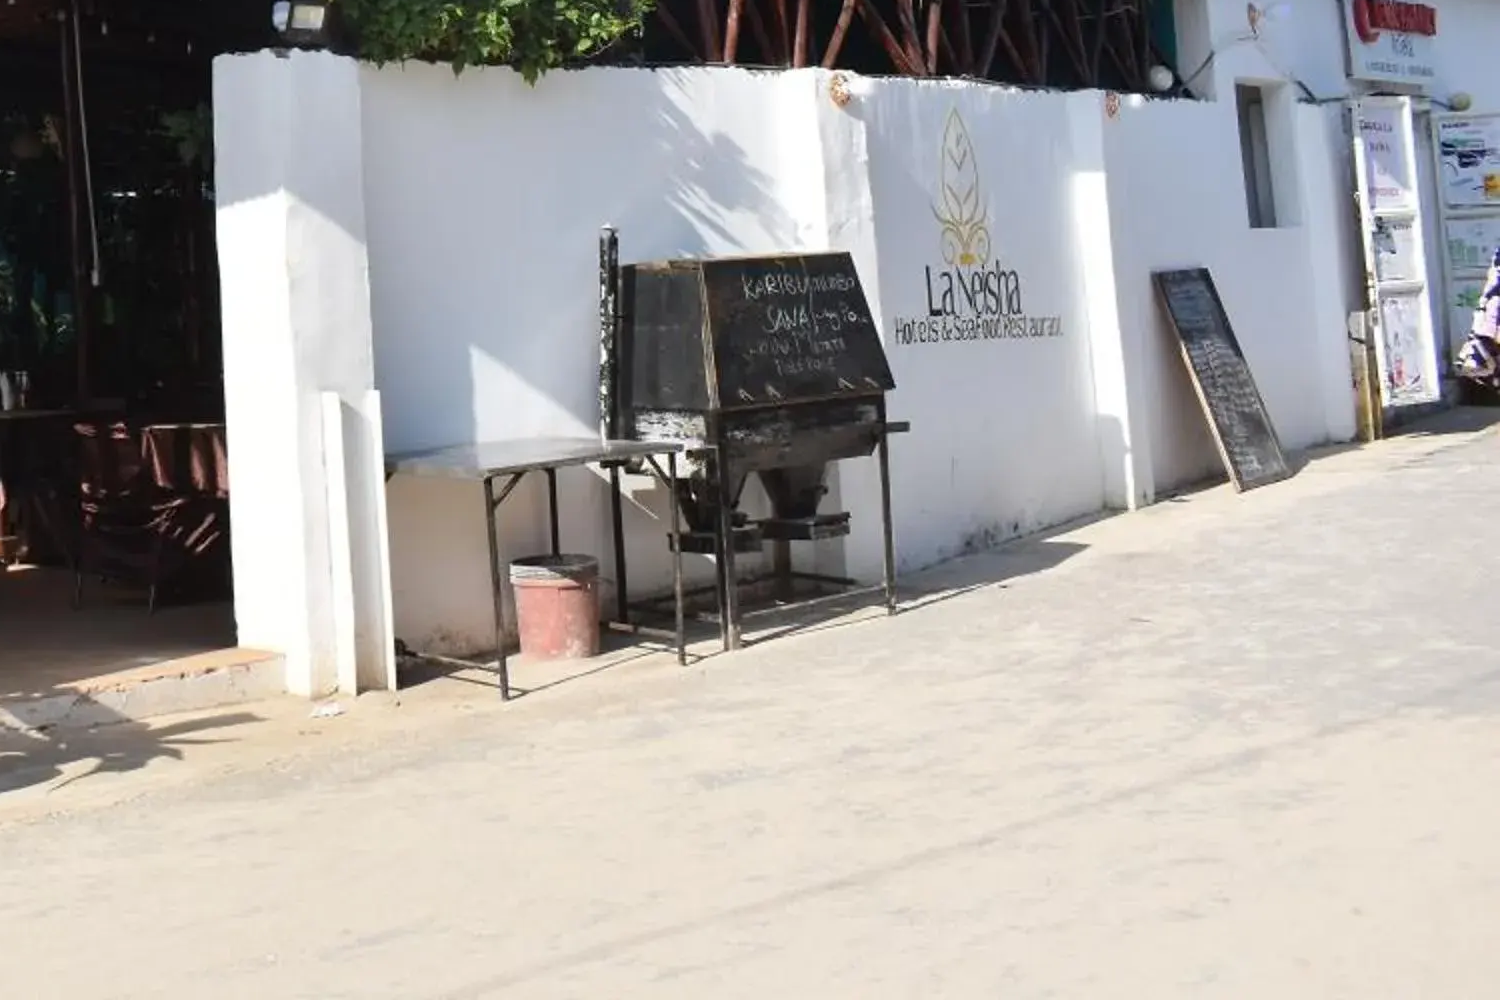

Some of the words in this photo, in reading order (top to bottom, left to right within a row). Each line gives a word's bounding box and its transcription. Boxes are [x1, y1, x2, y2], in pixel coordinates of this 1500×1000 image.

[741, 272, 809, 300] KARIBU
[762, 304, 812, 333] SANA
[895, 316, 939, 345] Hotels
